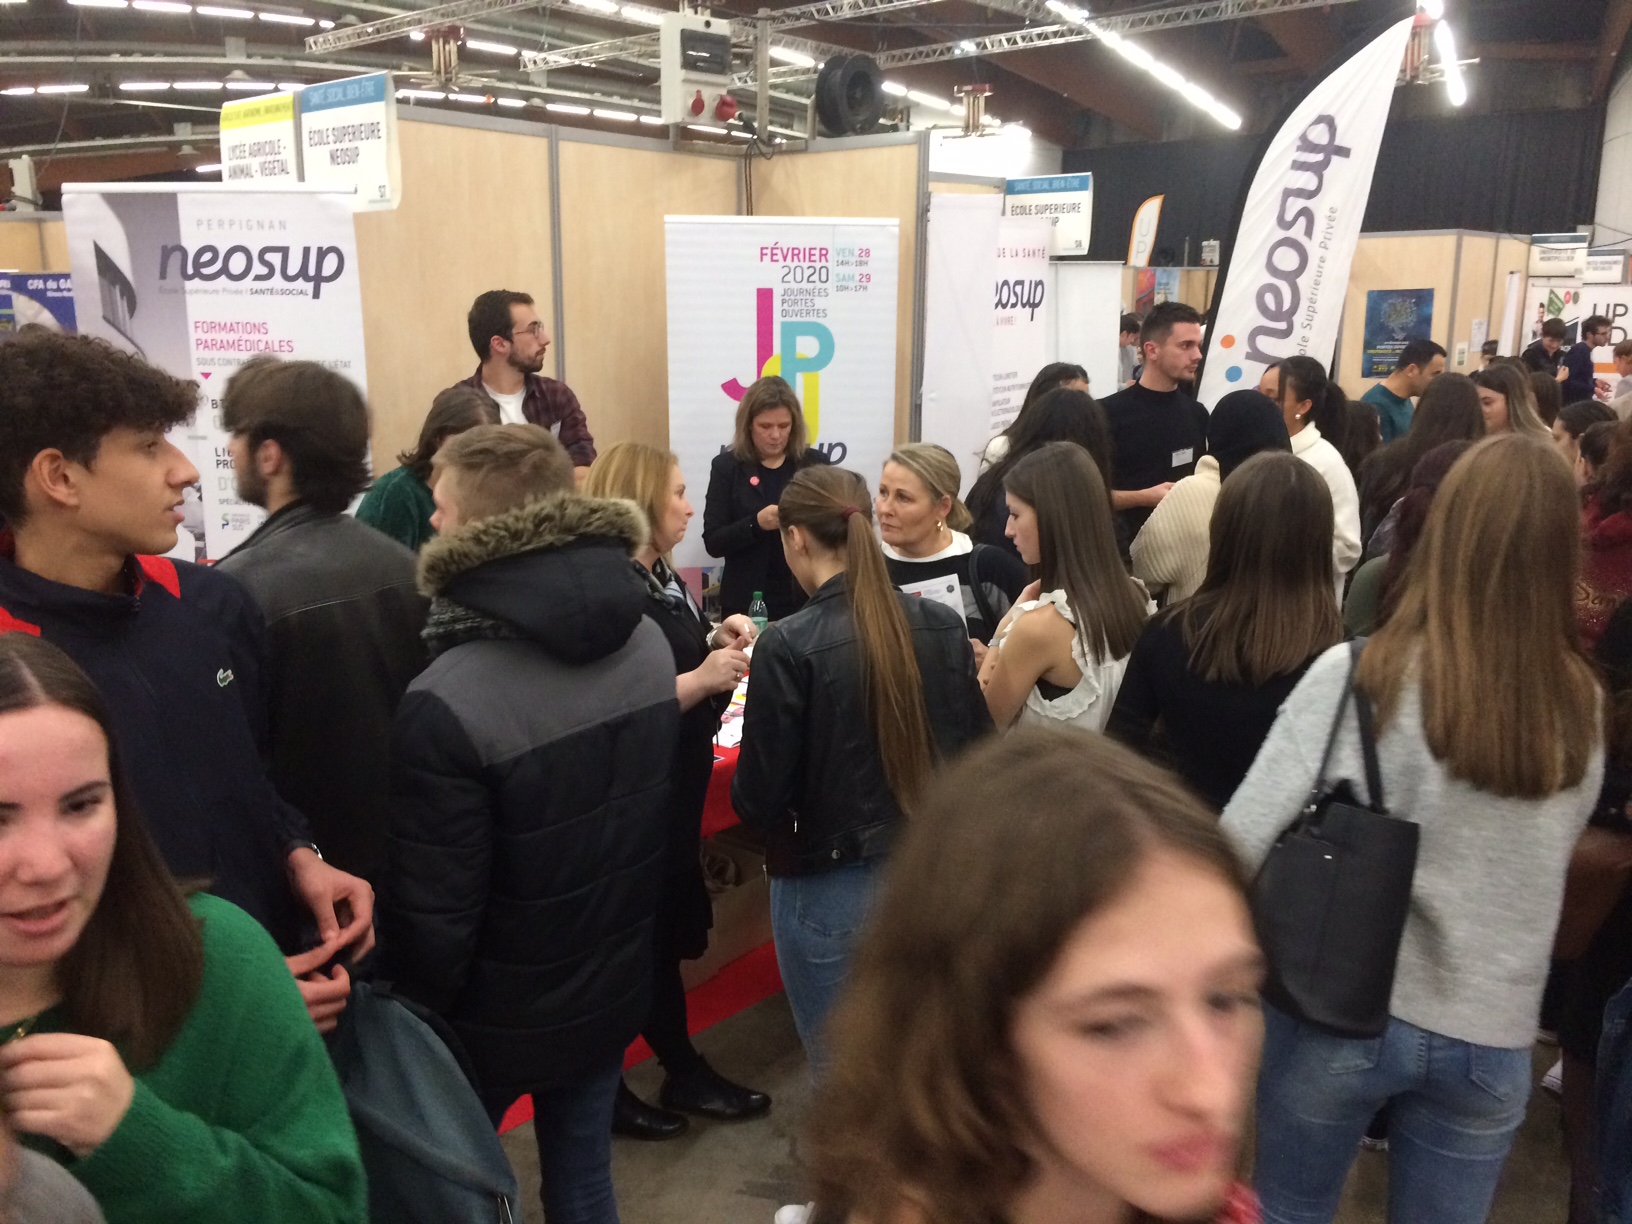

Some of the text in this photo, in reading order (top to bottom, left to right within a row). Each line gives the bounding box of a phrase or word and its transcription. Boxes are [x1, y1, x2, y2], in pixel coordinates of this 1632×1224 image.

[308, 121, 382, 147] ÉCOLE SUPERIEURE
[228, 141, 247, 161] LYCÉE
[248, 139, 282, 157] AGRICOLE
[329, 146, 360, 166] NEOSUP
[228, 162, 254, 180] ANIMAL
[1011, 202, 1081, 216] ÉCOLE SUPERIEURE
[197, 218, 287, 231] PERPIGNAN
[1244, 114, 1352, 366] neosup
[760, 241, 829, 263] FÉVRIER
[1023, 246, 1046, 259] SANTÉ
[159, 244, 345, 300] neosup
[781, 265, 830, 284] 2020
[1300, 254, 1327, 331] Supérieure
[1319, 205, 1338, 251] Privée
[27, 279, 45, 290] CFA
[249, 286, 309, 297] SANTÉ&SOCIAL
[780, 286, 830, 298] JOURNÉES
[781, 298, 816, 308] PORTES
[781, 308, 828, 318] OUVERTES
[194, 321, 269, 335] FORMATIONS
[195, 336, 294, 353] PARAMÉDICALES
[196, 357, 216, 366] SOUS
